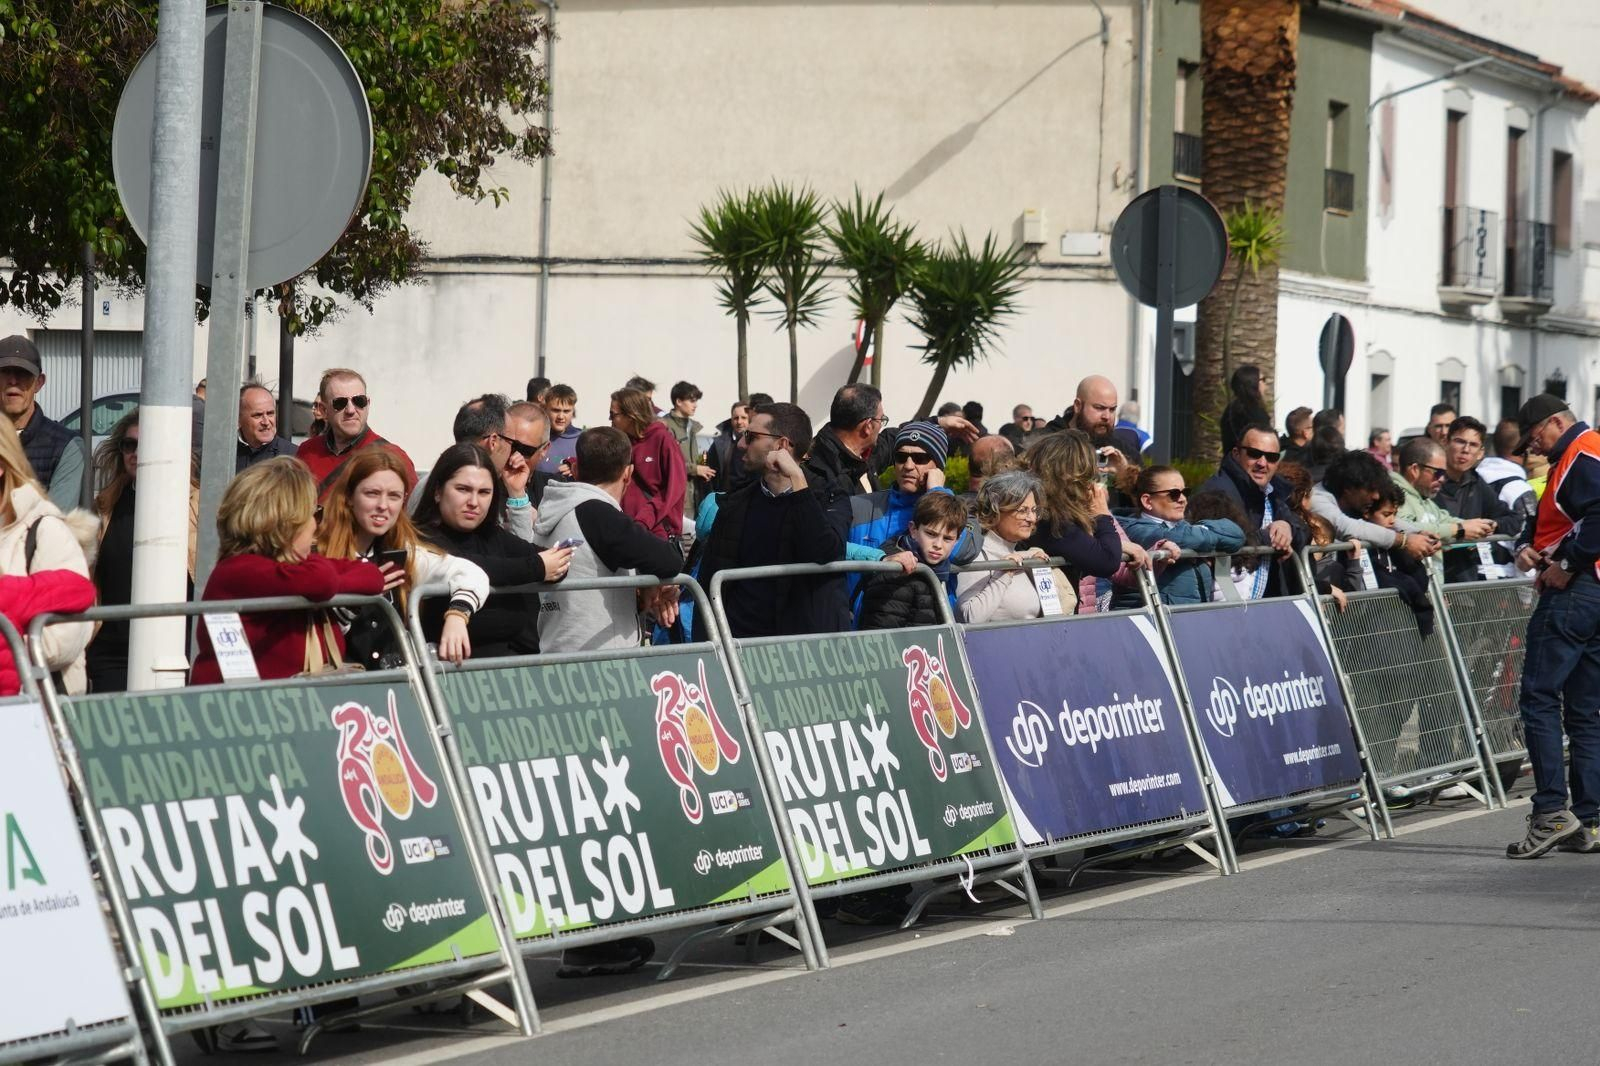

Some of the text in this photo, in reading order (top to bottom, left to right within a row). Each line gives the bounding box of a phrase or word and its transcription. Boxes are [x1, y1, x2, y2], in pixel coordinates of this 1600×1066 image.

[742, 632, 907, 686] VUELTA CICLISTA
[437, 659, 653, 716] VUELTA CICLISTA
[1243, 670, 1326, 726] deporinter
[64, 687, 333, 750] VUELTA CICLISTA
[1058, 692, 1165, 753] deporinter
[764, 720, 875, 802] RUTA
[952, 756, 965, 769] UCI
[1283, 743, 1341, 765] www.deporinter.com
[1109, 772, 1181, 796] www.deporinter.com
[467, 755, 608, 846] RUTA
[711, 794, 728, 809] UCI
[959, 801, 994, 821] deporinter
[101, 795, 277, 899] RUTA
[404, 842, 423, 858] UCI
[715, 845, 763, 869] deporinter
[0, 903, 18, 920] nta
[20, 900, 32, 915] de
[409, 898, 466, 925] deporinter
